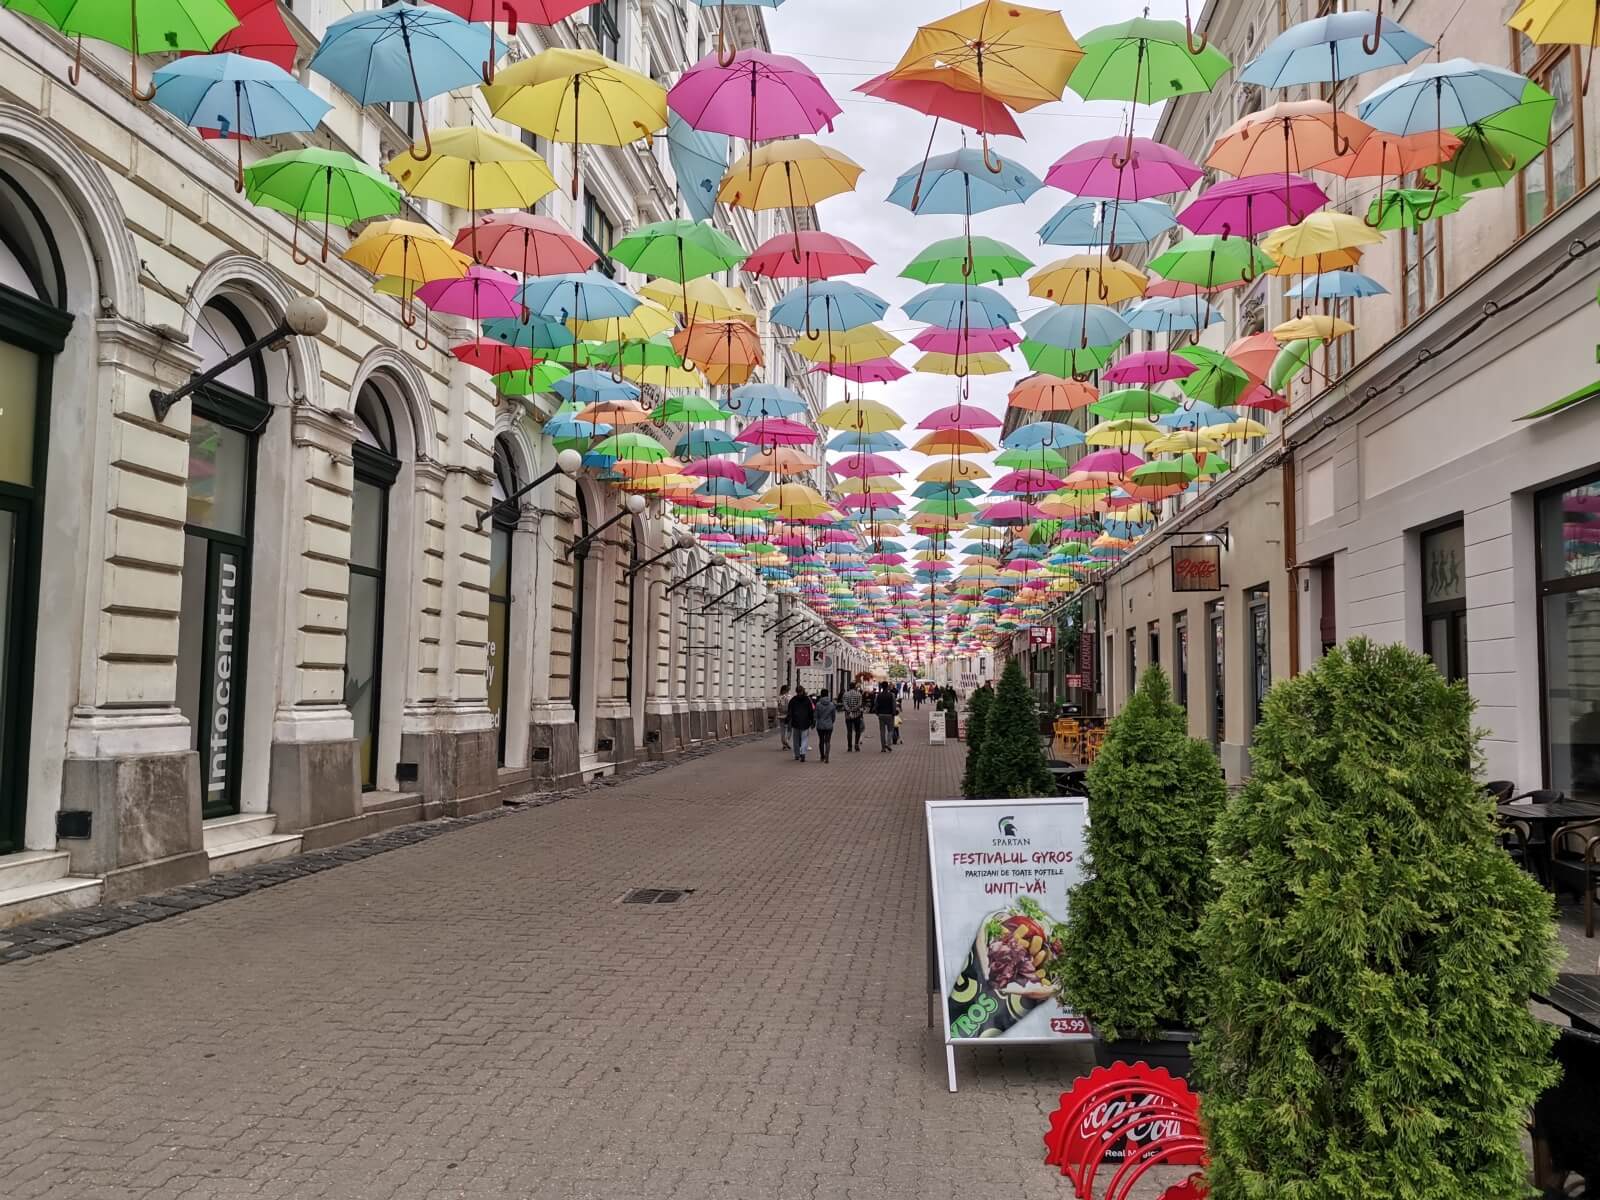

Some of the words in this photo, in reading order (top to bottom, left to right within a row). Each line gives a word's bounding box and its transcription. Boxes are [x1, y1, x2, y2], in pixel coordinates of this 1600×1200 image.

[208, 563, 237, 792] Infocentru
[992, 839, 1031, 847] SPARTAN
[953, 852, 1028, 865] FESTIVALUL
[1032, 851, 1073, 864] GYROS
[965, 870, 999, 878] PARTIZANI
[1011, 869, 1032, 877] TOATE
[1054, 1020, 1085, 1031] 23.99
[1105, 1149, 1126, 1157] Real
[1127, 1149, 1157, 1159] Mgic
